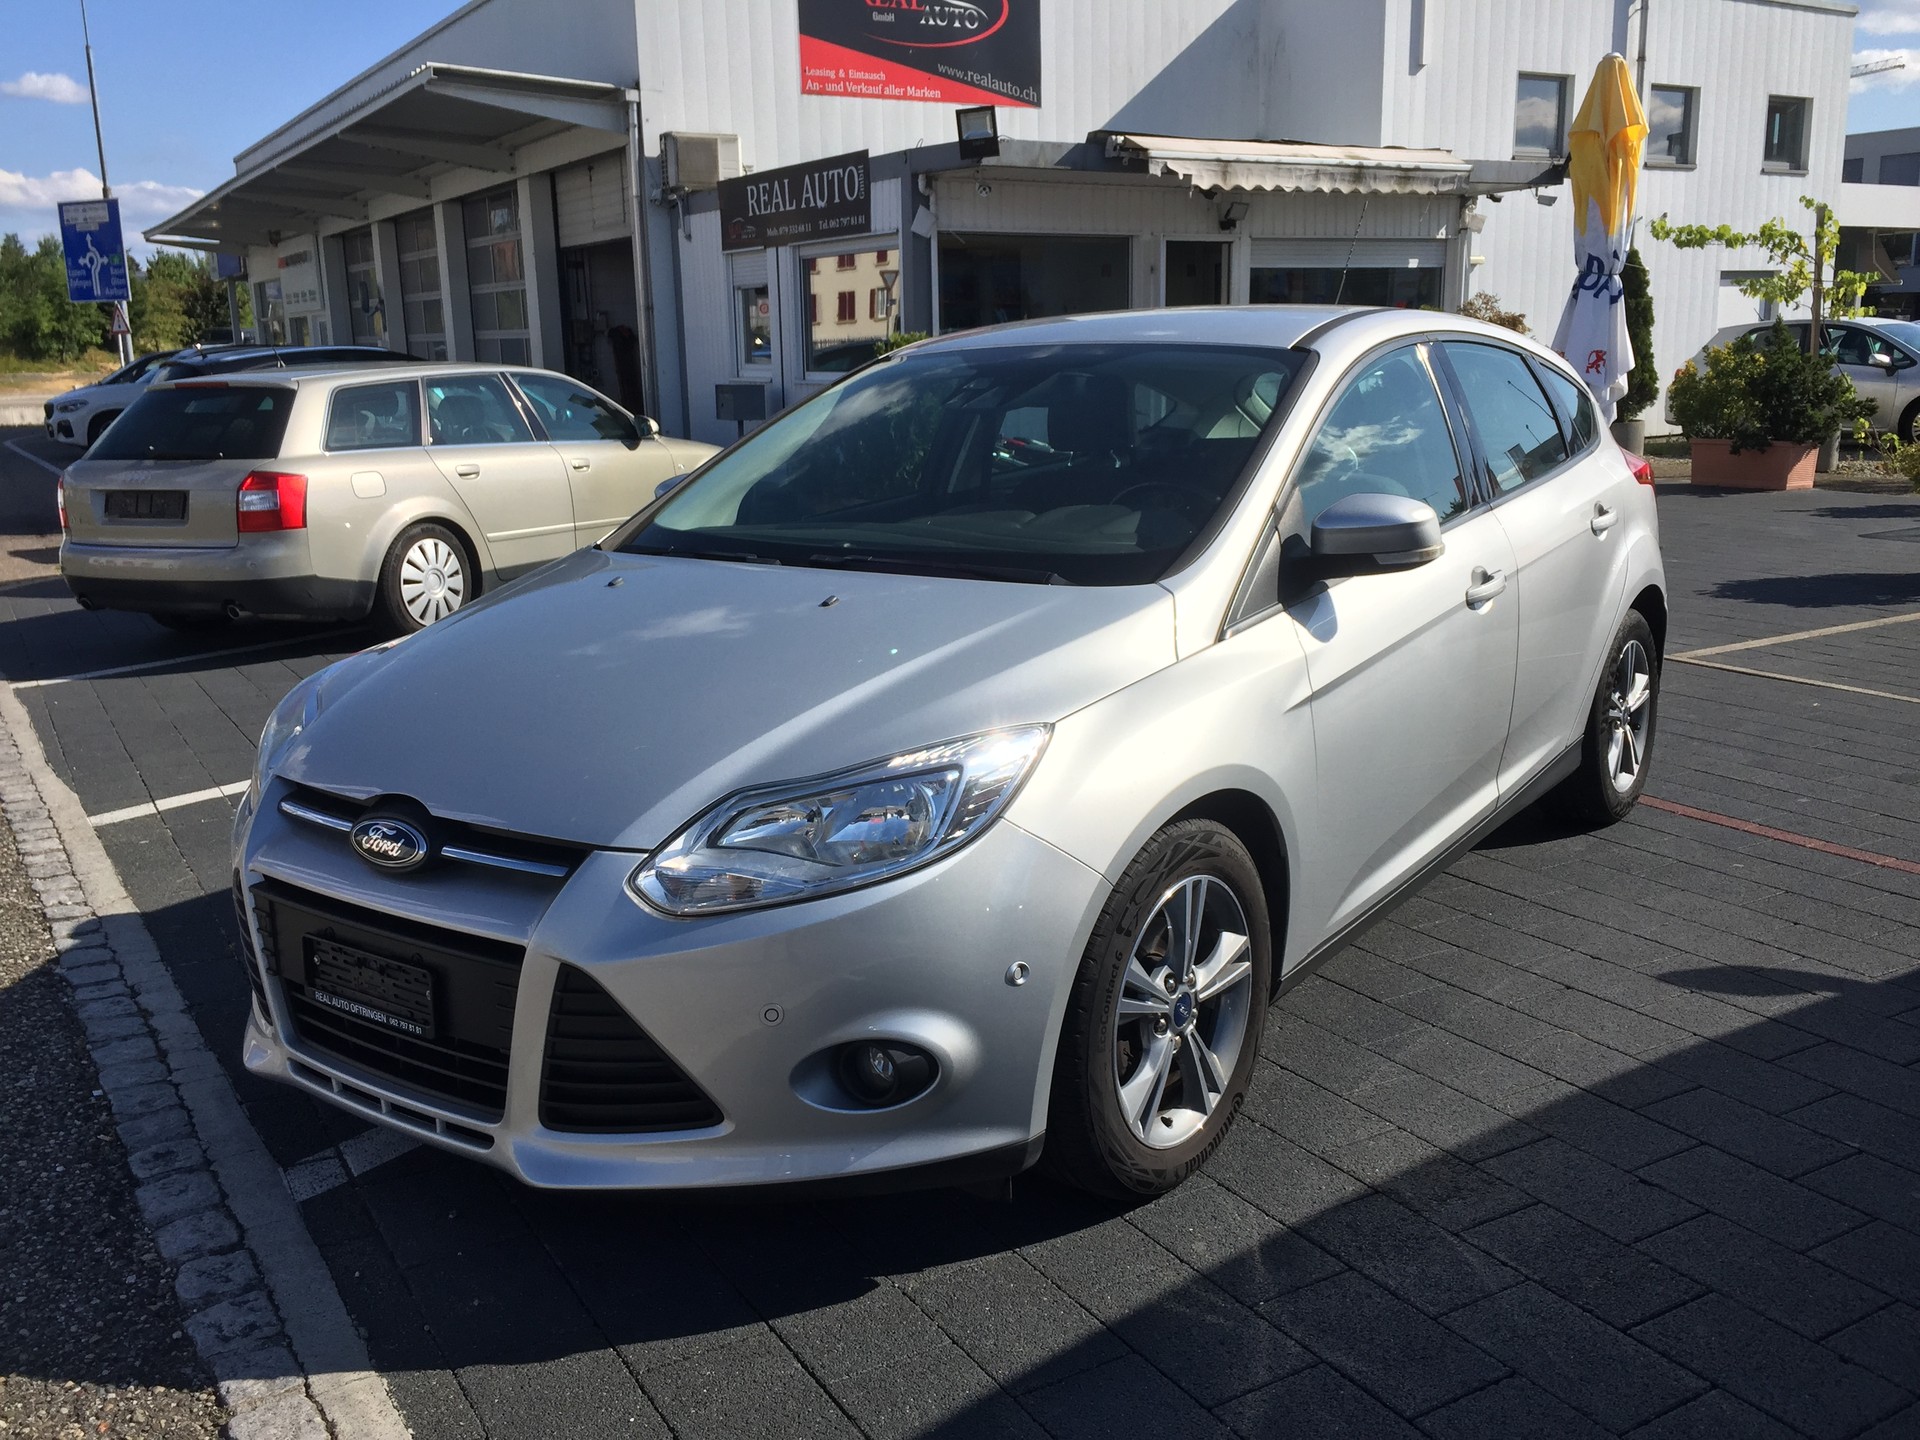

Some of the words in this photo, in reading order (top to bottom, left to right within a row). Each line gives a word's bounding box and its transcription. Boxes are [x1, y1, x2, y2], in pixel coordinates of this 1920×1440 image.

[872, 11, 895, 22] GmbH
[920, 4, 979, 29] AUTO
[805, 66, 836, 79] Leasing
[838, 68, 845, 78] &
[848, 69, 886, 81] Eintausch
[806, 79, 823, 91] An-
[825, 81, 844, 92] und
[846, 81, 882, 94] Verkauf
[883, 84, 905, 96] aller
[906, 86, 941, 98] Marken
[937, 63, 1038, 103] www.realauto.ch
[746, 178, 797, 217] REAL
[801, 165, 859, 209] AUTO
[362, 824, 405, 857] Ford
[315, 991, 332, 1005] REAL
[332, 997, 349, 1011] AUTO
[350, 1003, 387, 1024] OFTRINGEN
